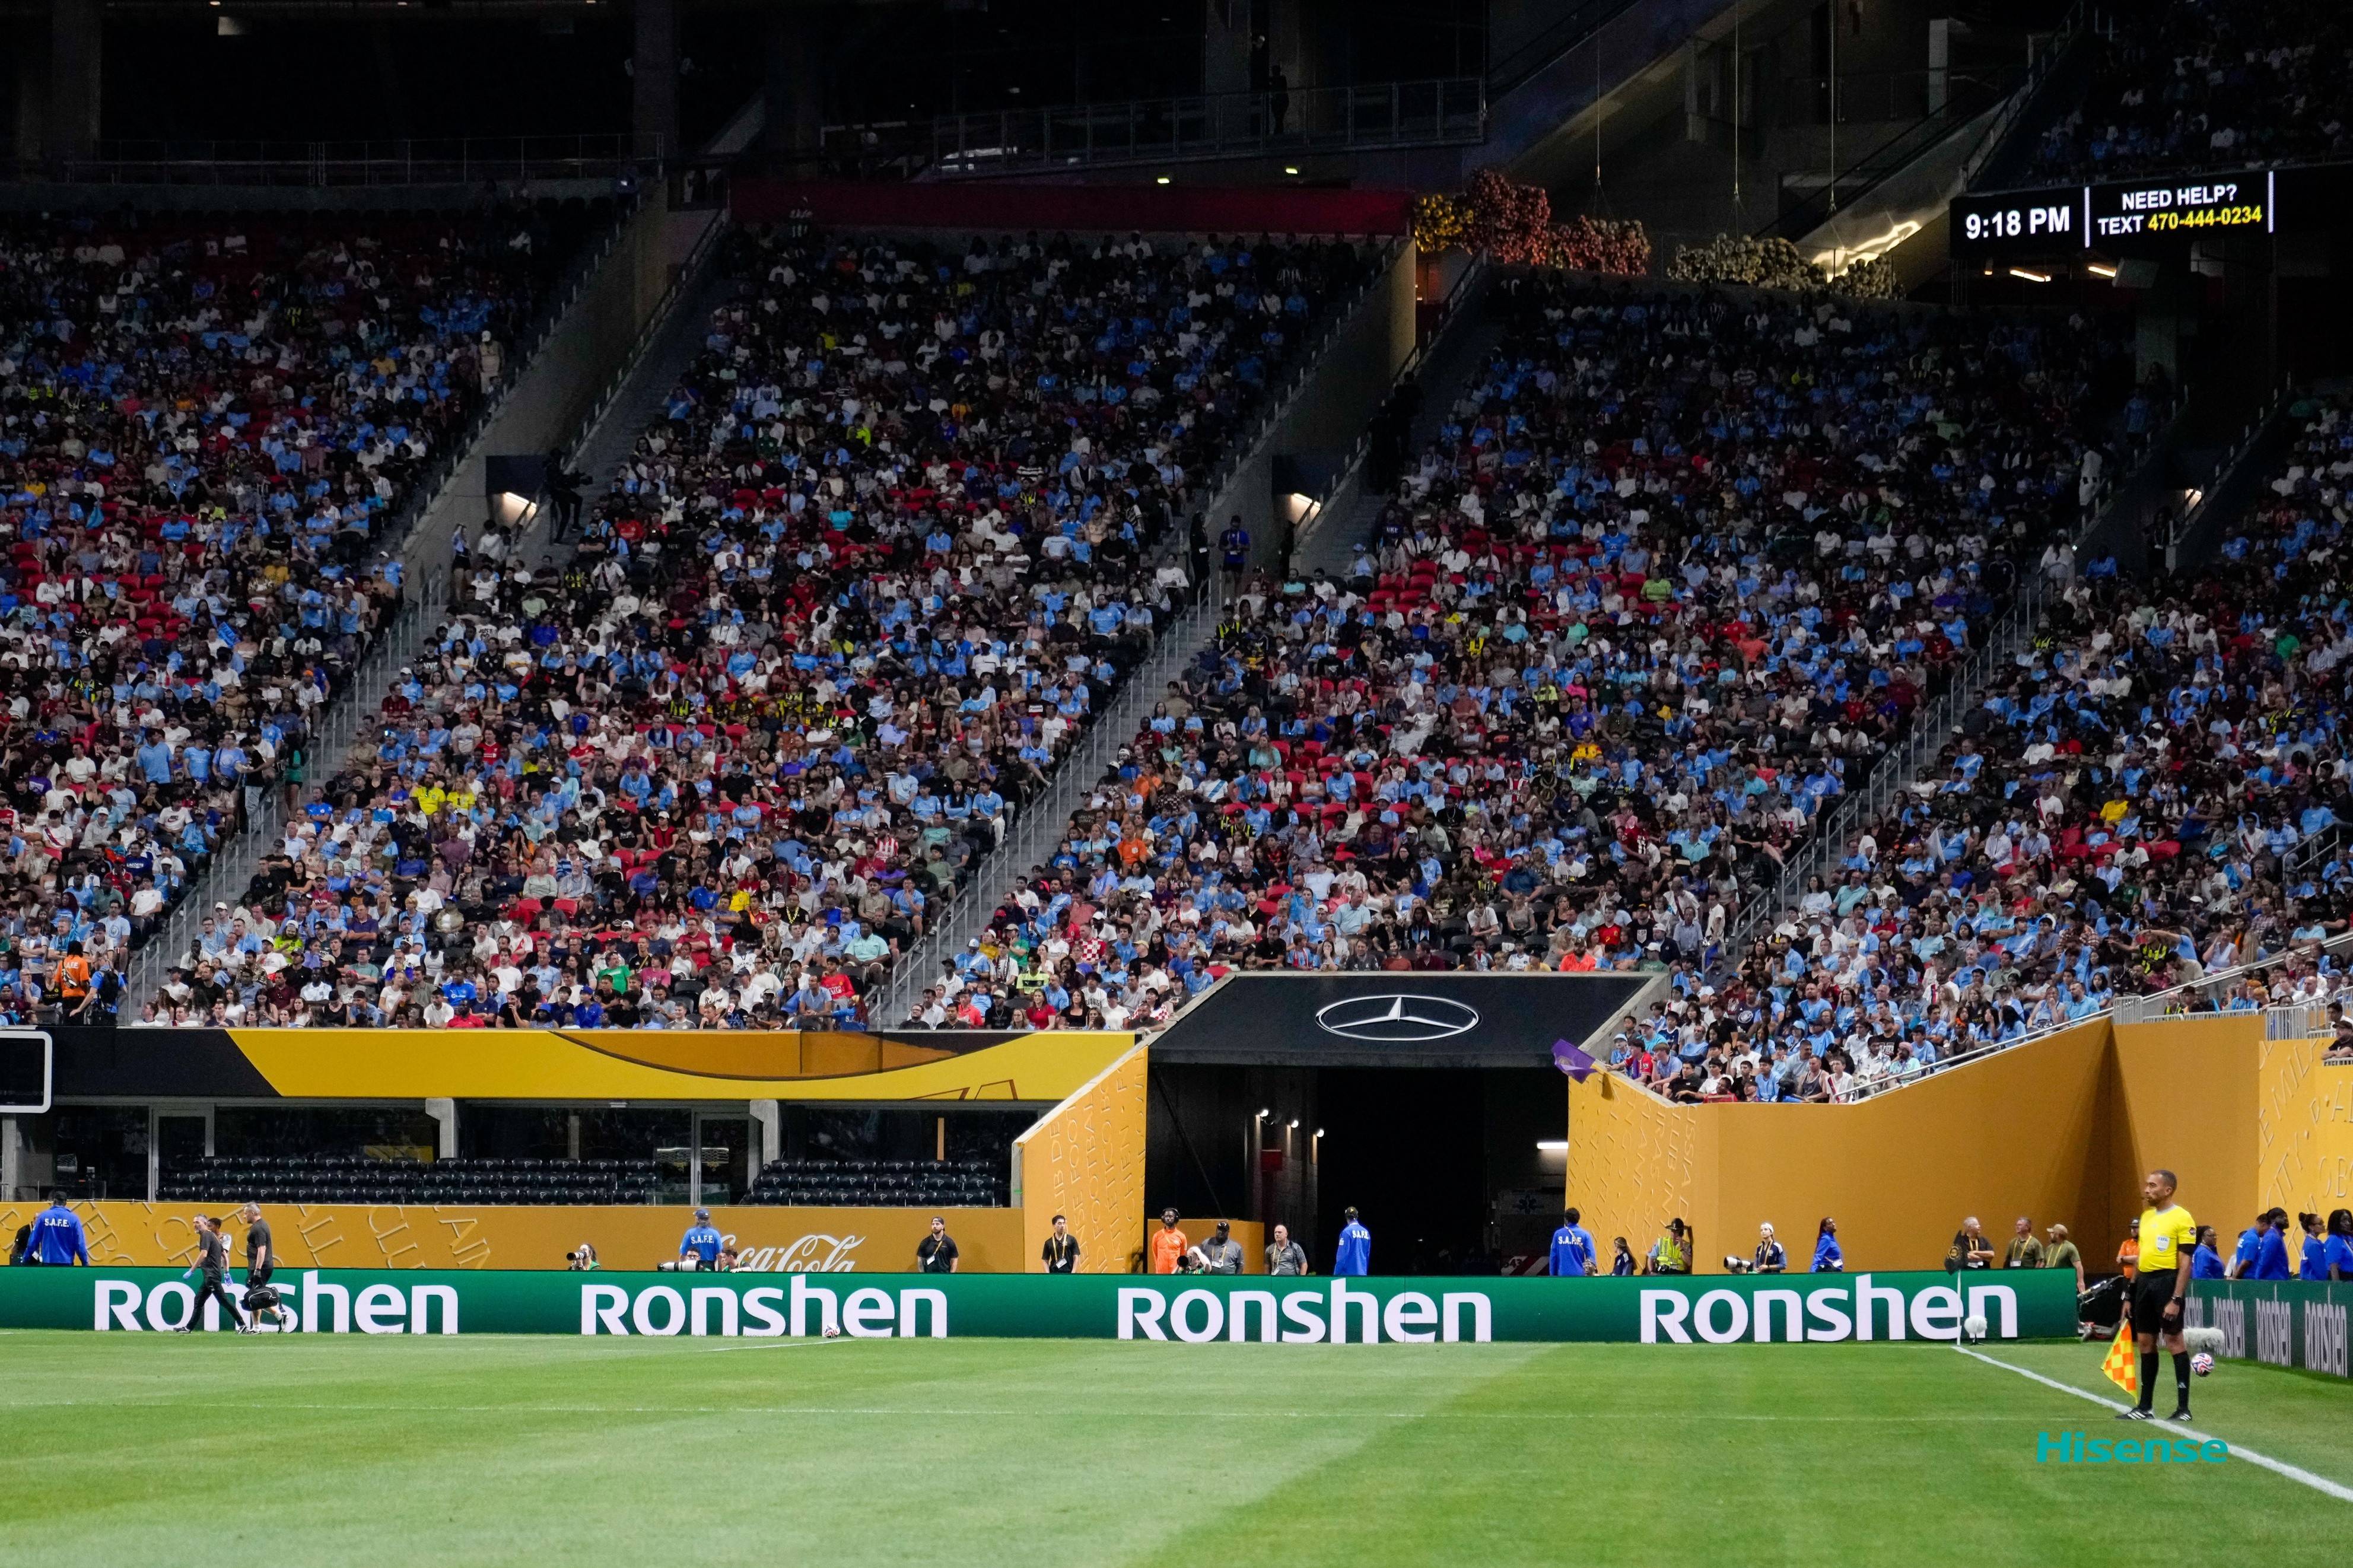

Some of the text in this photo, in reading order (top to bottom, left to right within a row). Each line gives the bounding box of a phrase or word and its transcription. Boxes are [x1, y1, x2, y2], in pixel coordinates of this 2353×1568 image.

[2122, 183, 2238, 211] NEED HELP?
[1966, 206, 2070, 240] 9:18 PM
[2097, 205, 2262, 236] TEXT 470-444-0234
[44, 1217, 69, 1227] S.A.F.E.
[581, 1274, 947, 1338] Ronshen
[1117, 1277, 1492, 1343] Ronshen
[1640, 1273, 2018, 1344] Ronshen
